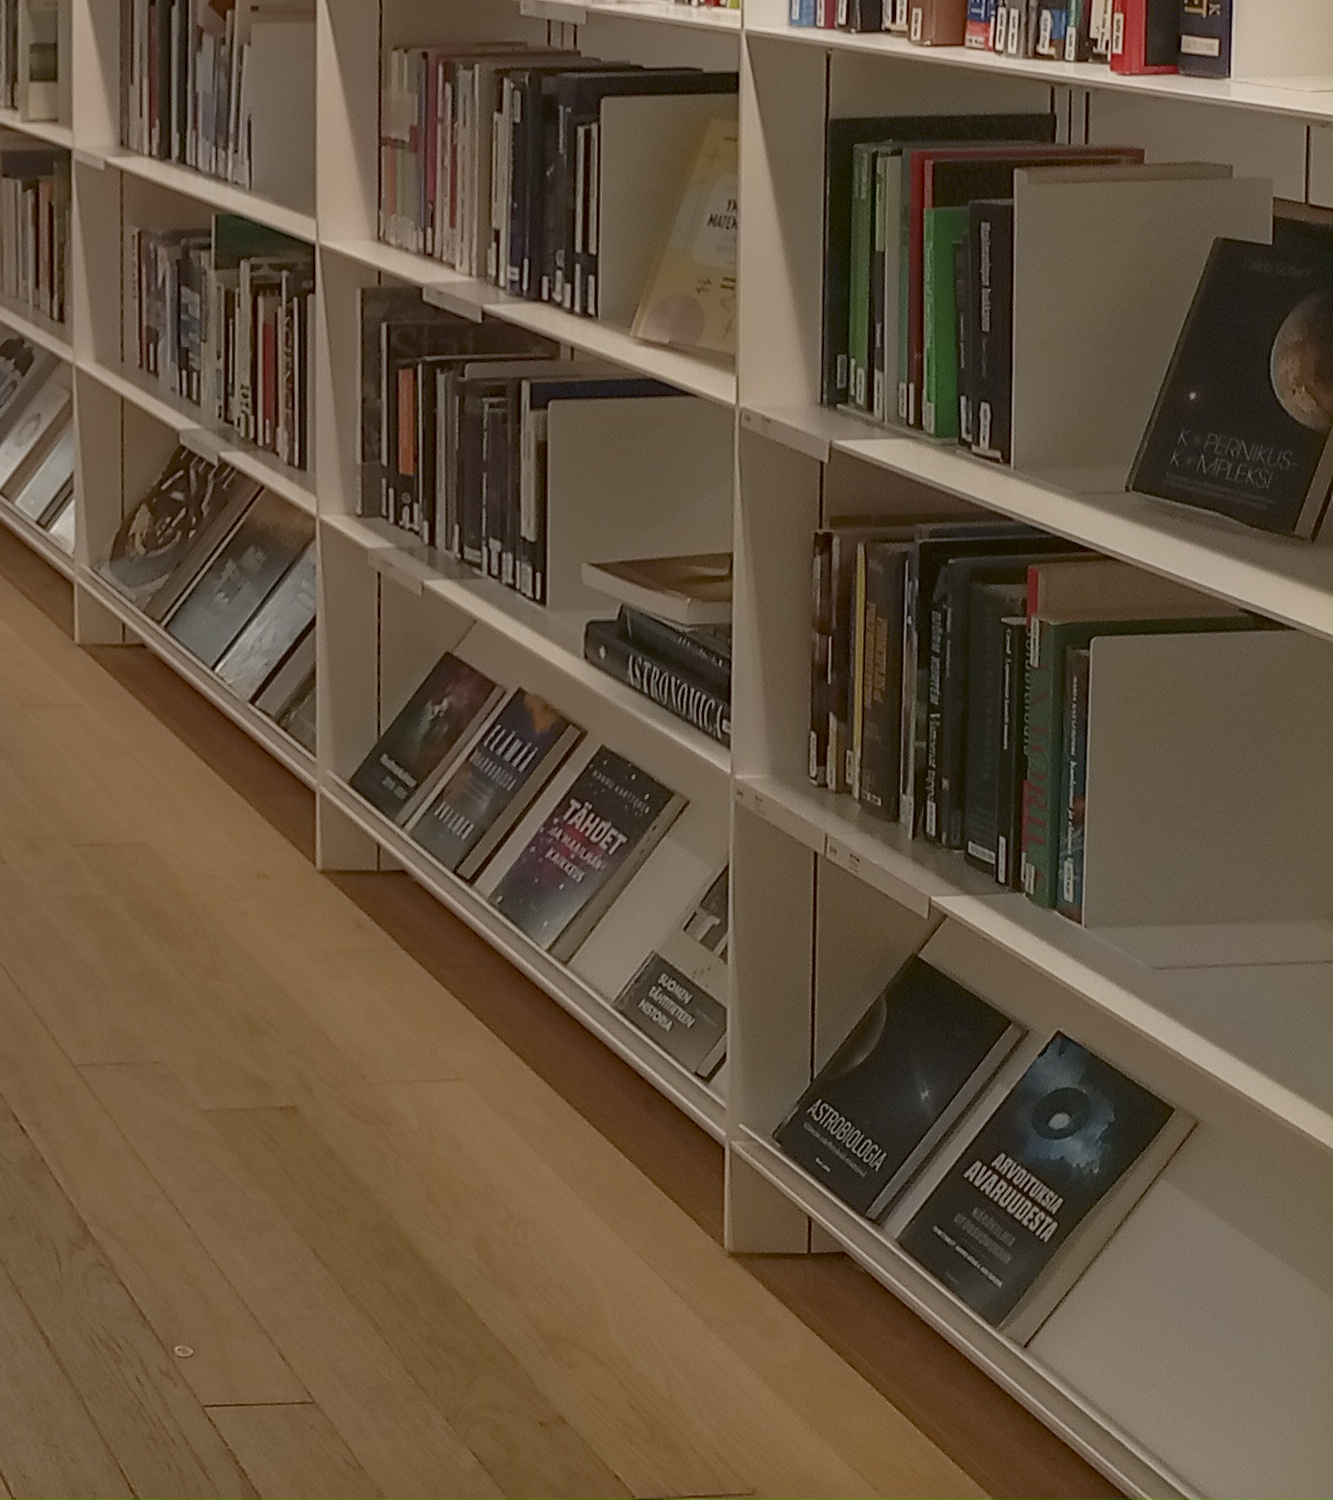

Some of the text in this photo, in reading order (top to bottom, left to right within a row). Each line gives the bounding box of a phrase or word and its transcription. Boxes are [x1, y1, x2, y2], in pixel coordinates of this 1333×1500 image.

[563, 799, 628, 855] TÄHDET
[638, 998, 674, 1032] HISTORIA
[657, 972, 693, 1004] SUOMEN
[806, 1098, 888, 1173] ASTROBIOLOGIA
[963, 1159, 1060, 1243] AVARUUDESTA
[990, 1152, 1065, 1215] ARVOITUKSIA
